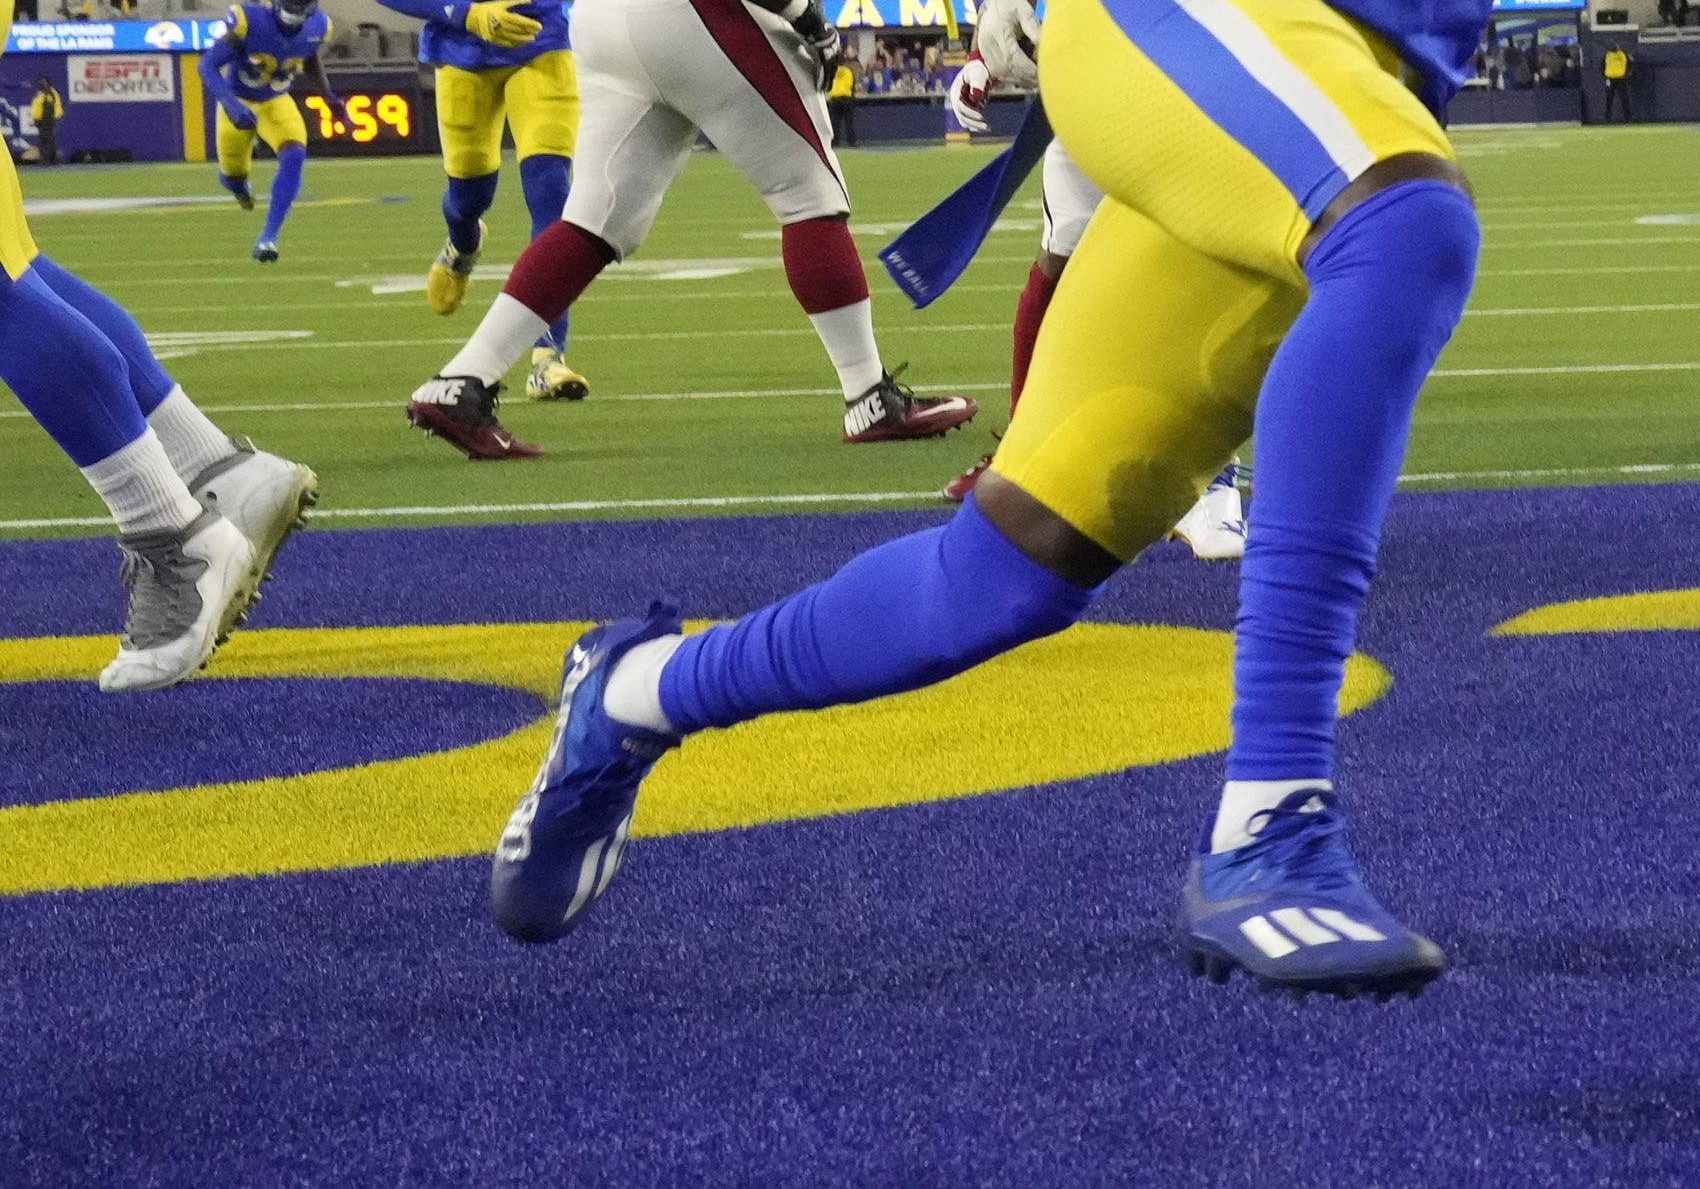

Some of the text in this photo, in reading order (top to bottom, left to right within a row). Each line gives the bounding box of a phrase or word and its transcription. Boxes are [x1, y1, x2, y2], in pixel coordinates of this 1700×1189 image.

[85, 60, 160, 80] ESPN
[73, 80, 169, 95] DEPORTES
[844, 390, 887, 438] NIKE
